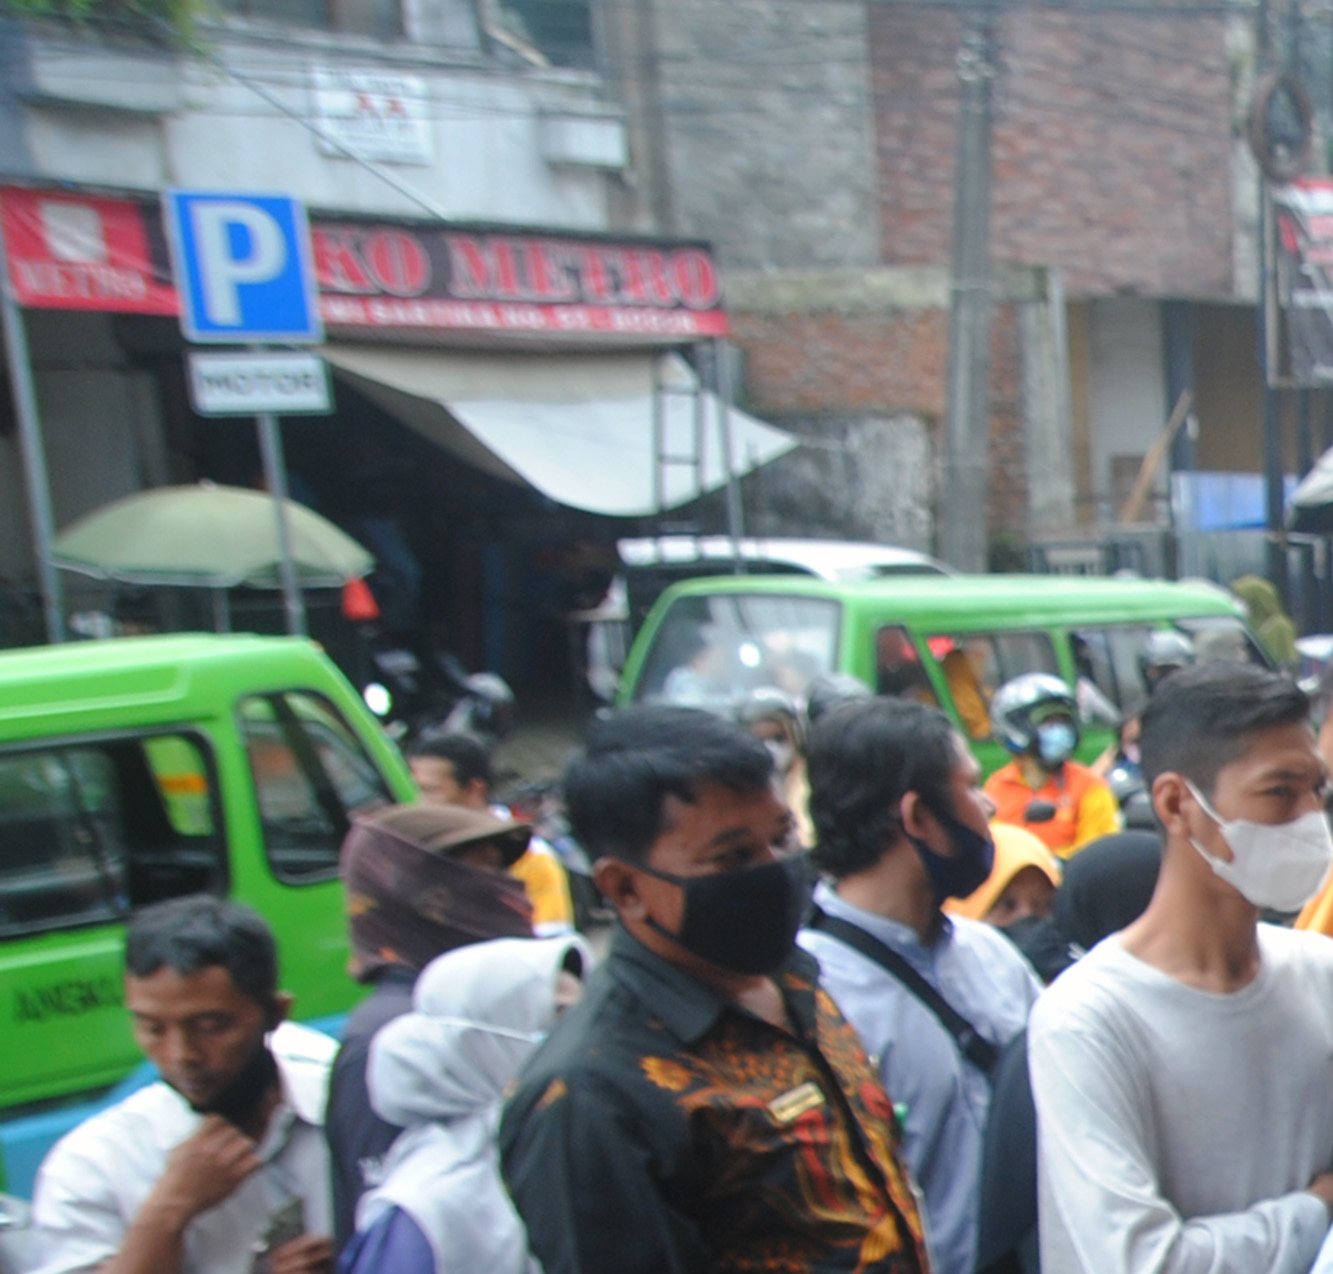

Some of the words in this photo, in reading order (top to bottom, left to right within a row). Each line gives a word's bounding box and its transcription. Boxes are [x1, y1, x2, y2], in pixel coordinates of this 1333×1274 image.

[190, 202, 288, 327] P
[311, 222, 430, 298] KO
[445, 231, 723, 311] METRO
[202, 372, 319, 396] MOTOR
